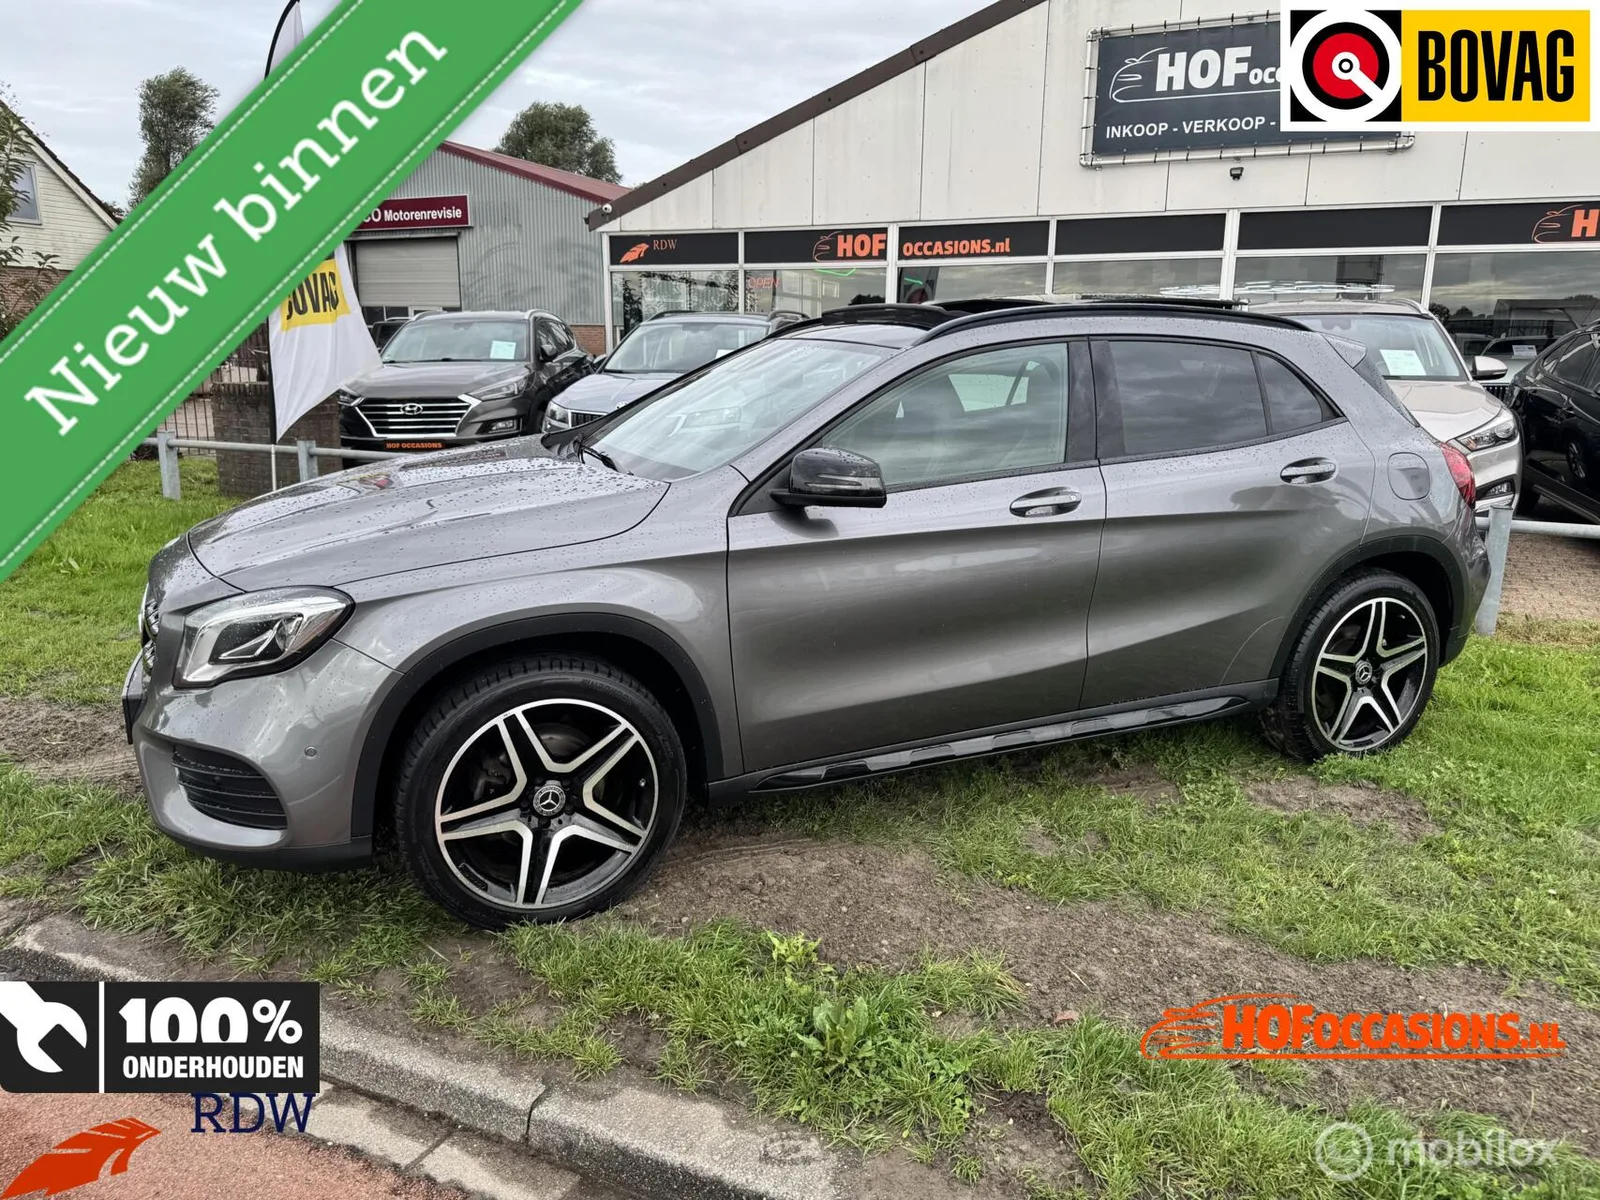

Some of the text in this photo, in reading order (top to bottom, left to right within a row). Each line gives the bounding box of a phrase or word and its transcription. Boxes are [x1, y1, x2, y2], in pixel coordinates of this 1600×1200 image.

[1106, 122, 1169, 139] INKOOP
[1182, 116, 1266, 134] VERKOOP
[384, 206, 463, 222] Motorenrevisie
[652, 239, 678, 251] RDW
[836, 233, 887, 257] HOF
[748, 276, 780, 289] OPEN
